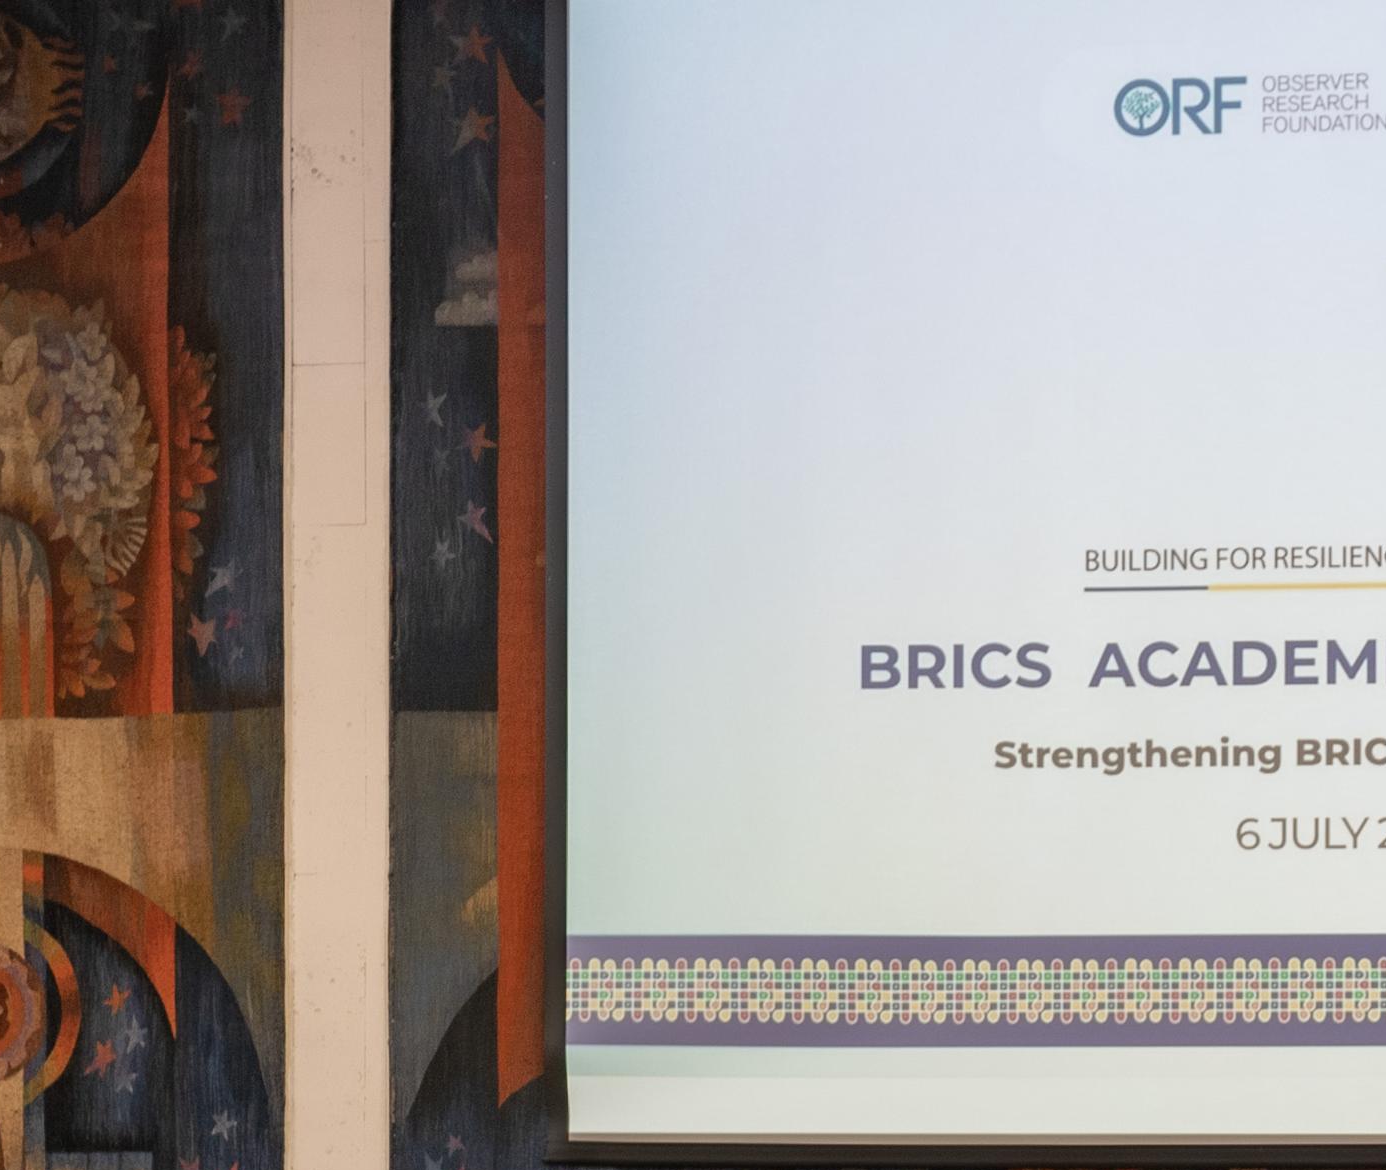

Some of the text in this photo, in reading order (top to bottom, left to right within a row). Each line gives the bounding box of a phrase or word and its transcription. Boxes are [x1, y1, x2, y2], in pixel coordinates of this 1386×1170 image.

[1262, 73, 1370, 93] OBSERVER
[1114, 76, 1248, 138] ORF
[1262, 94, 1370, 113] RESEARCH
[1086, 548, 1209, 574] BUILDING
[1217, 547, 1268, 572] FOR
[861, 641, 1053, 691] BRICS
[994, 736, 1283, 777] Strengthening
[1235, 817, 1262, 852] 6
[1268, 817, 1371, 852] JULY
